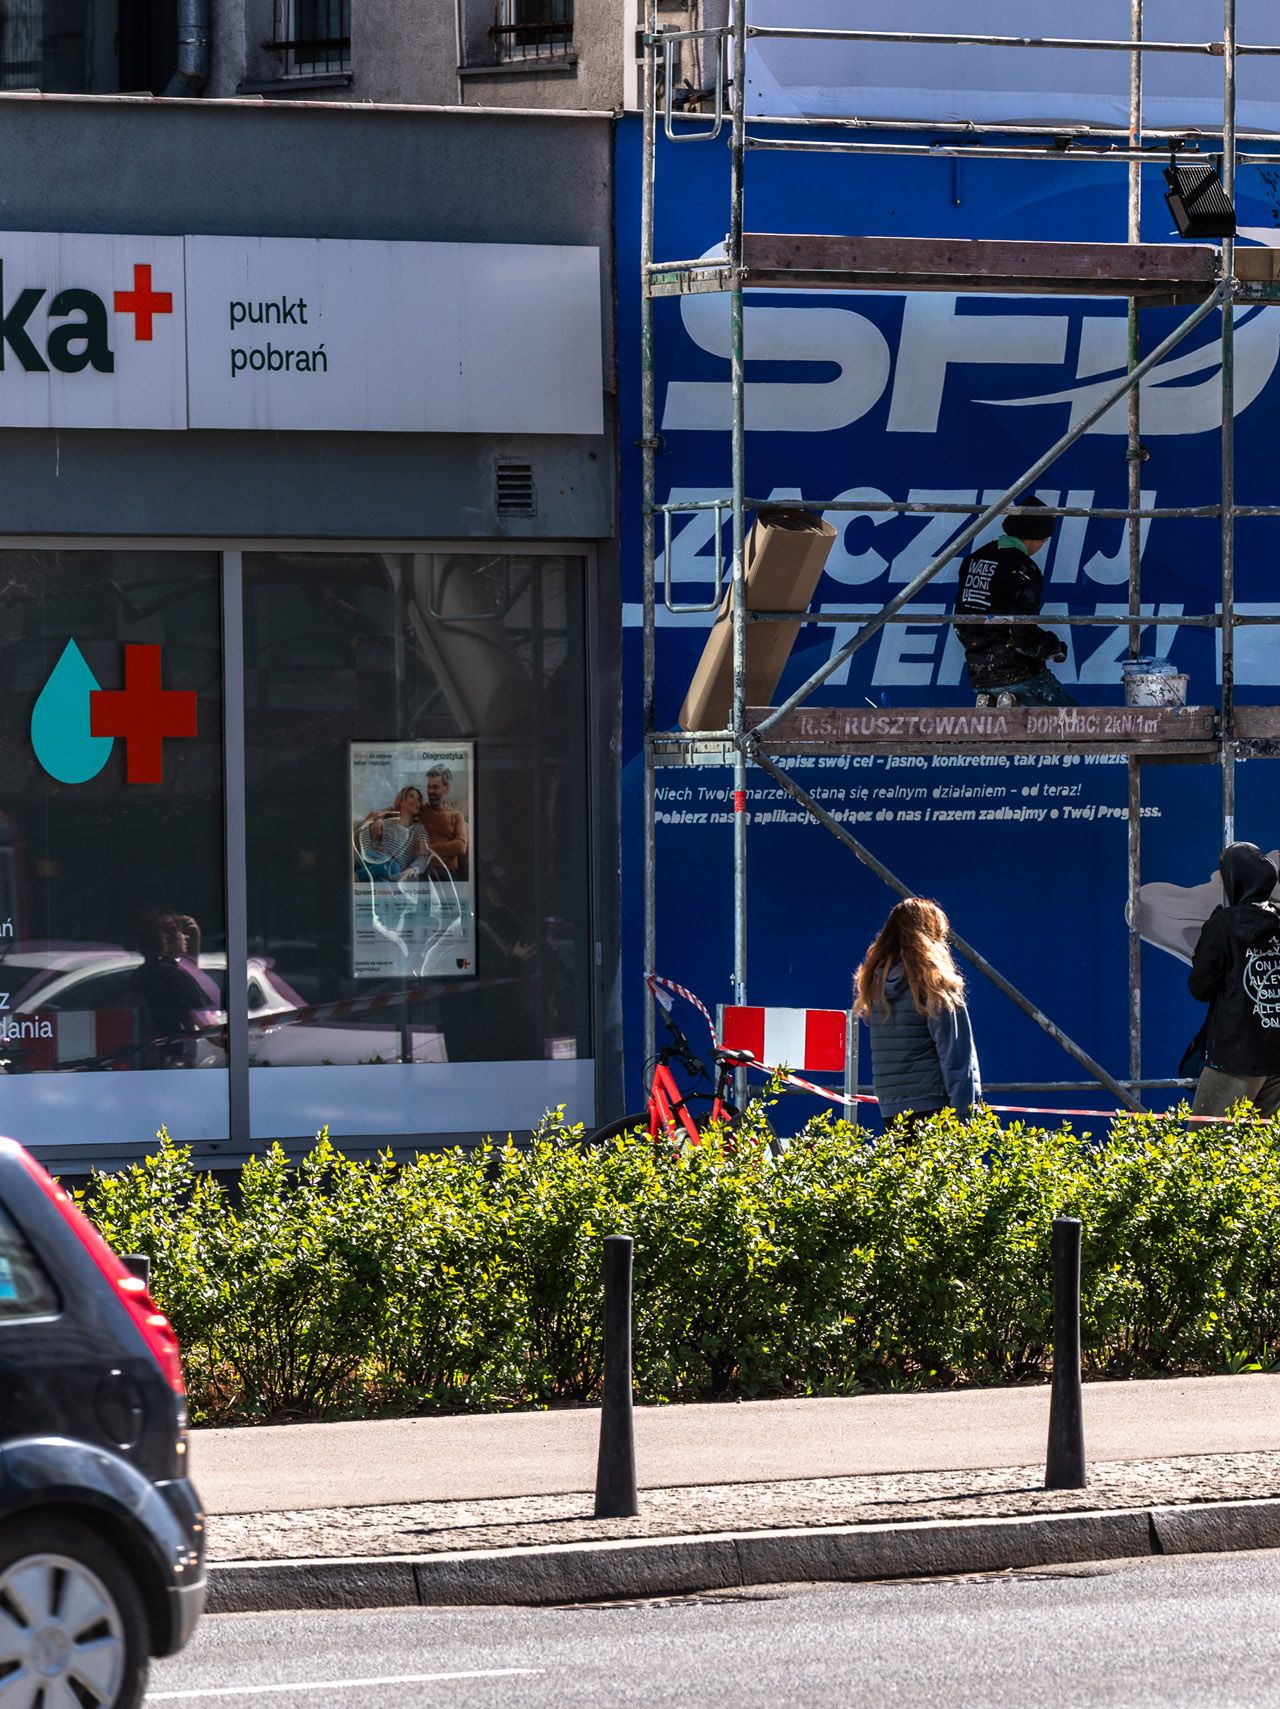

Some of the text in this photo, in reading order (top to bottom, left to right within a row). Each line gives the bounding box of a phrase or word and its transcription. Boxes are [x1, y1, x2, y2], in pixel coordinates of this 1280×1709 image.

[230, 296, 308, 330] punkt
[231, 343, 328, 378] pobrań
[654, 486, 1157, 585] ZCZIJ
[844, 716, 1009, 736] RUSZTOWANIA
[422, 751, 464, 761] Diagnostyka
[769, 755, 815, 770] Zapisz
[818, 755, 852, 770] swój
[853, 755, 874, 768] cel
[885, 755, 929, 770] jasno,
[932, 755, 1010, 768] konkretnie,
[1014, 755, 1035, 767] tak
[1037, 755, 1060, 767] jak
[1062, 755, 1081, 768] go
[1084, 754, 1129, 765] widzis
[654, 788, 692, 801] Niech
[697, 787, 735, 802] Twoje
[809, 786, 846, 801] staną
[849, 786, 869, 801] się
[872, 785, 927, 800] realnym
[932, 784, 1006, 798] działaniem
[1021, 784, 1040, 797] od
[1043, 783, 1082, 797] teraz!
[654, 810, 708, 824] Pobierz
[709, 811, 751, 825] nasą
[875, 808, 895, 822] do
[896, 809, 922, 822] nas
[925, 808, 931, 821] i
[932, 808, 976, 822] razem
[978, 806, 1047, 821] zadbajmy
[1050, 808, 1059, 819] o
[1063, 805, 1095, 821] Twój
[1097, 805, 1162, 821] Progess.
[1255, 960, 1271, 971] ON
